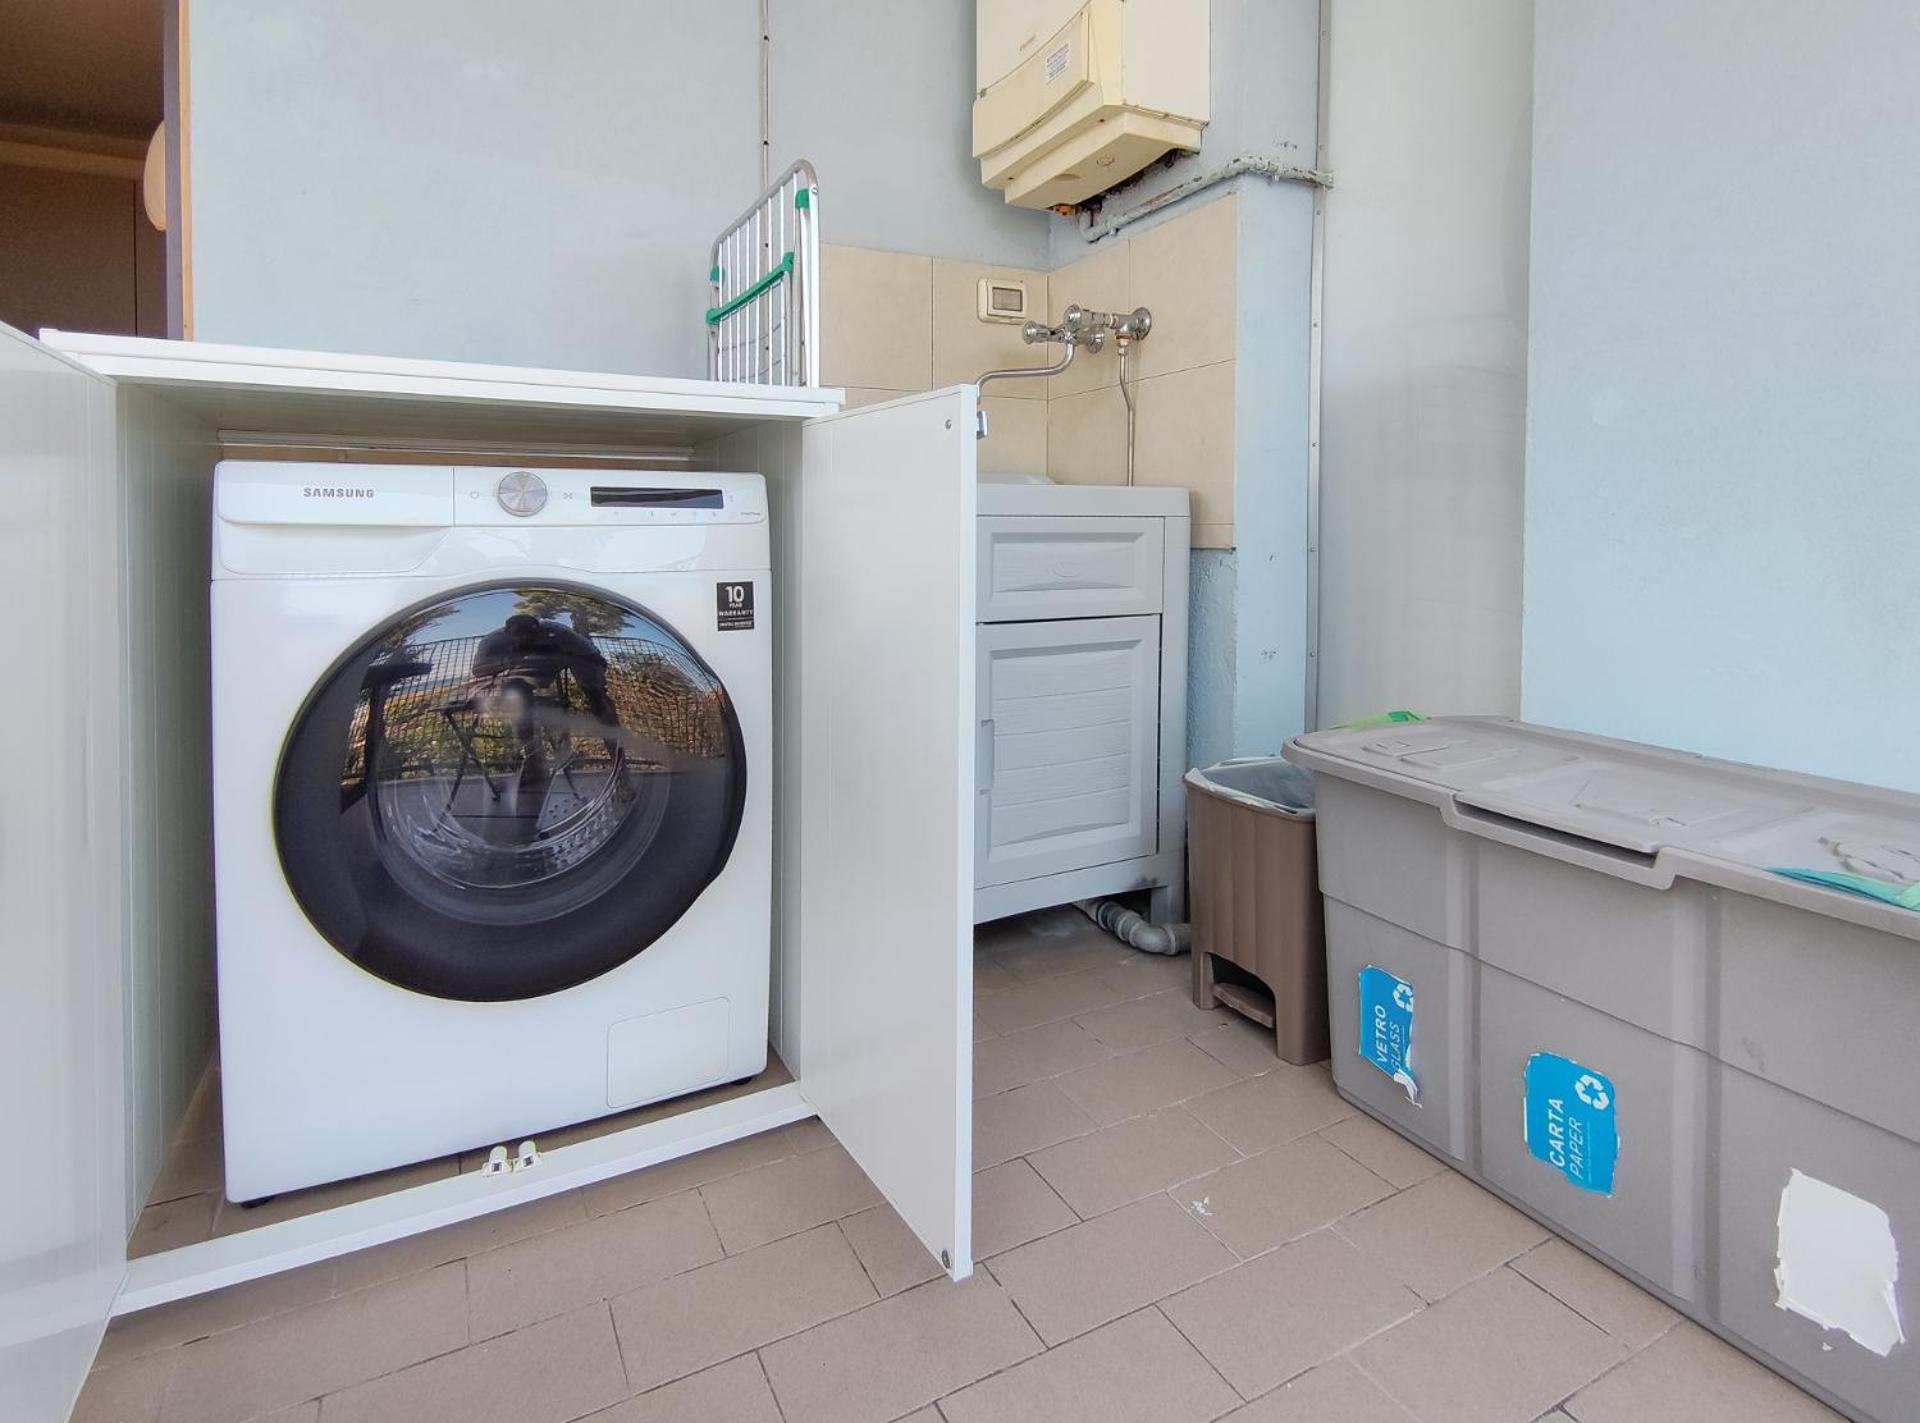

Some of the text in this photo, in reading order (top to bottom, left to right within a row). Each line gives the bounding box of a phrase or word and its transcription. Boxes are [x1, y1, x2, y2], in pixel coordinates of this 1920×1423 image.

[303, 488, 374, 498] SAMSUNG
[725, 585, 744, 602] 10
[1374, 1004, 1388, 1063] VETRO
[1389, 1022, 1401, 1071] GLASS
[1548, 1098, 1565, 1167] CARTA
[1568, 1116, 1584, 1180] PAPER
